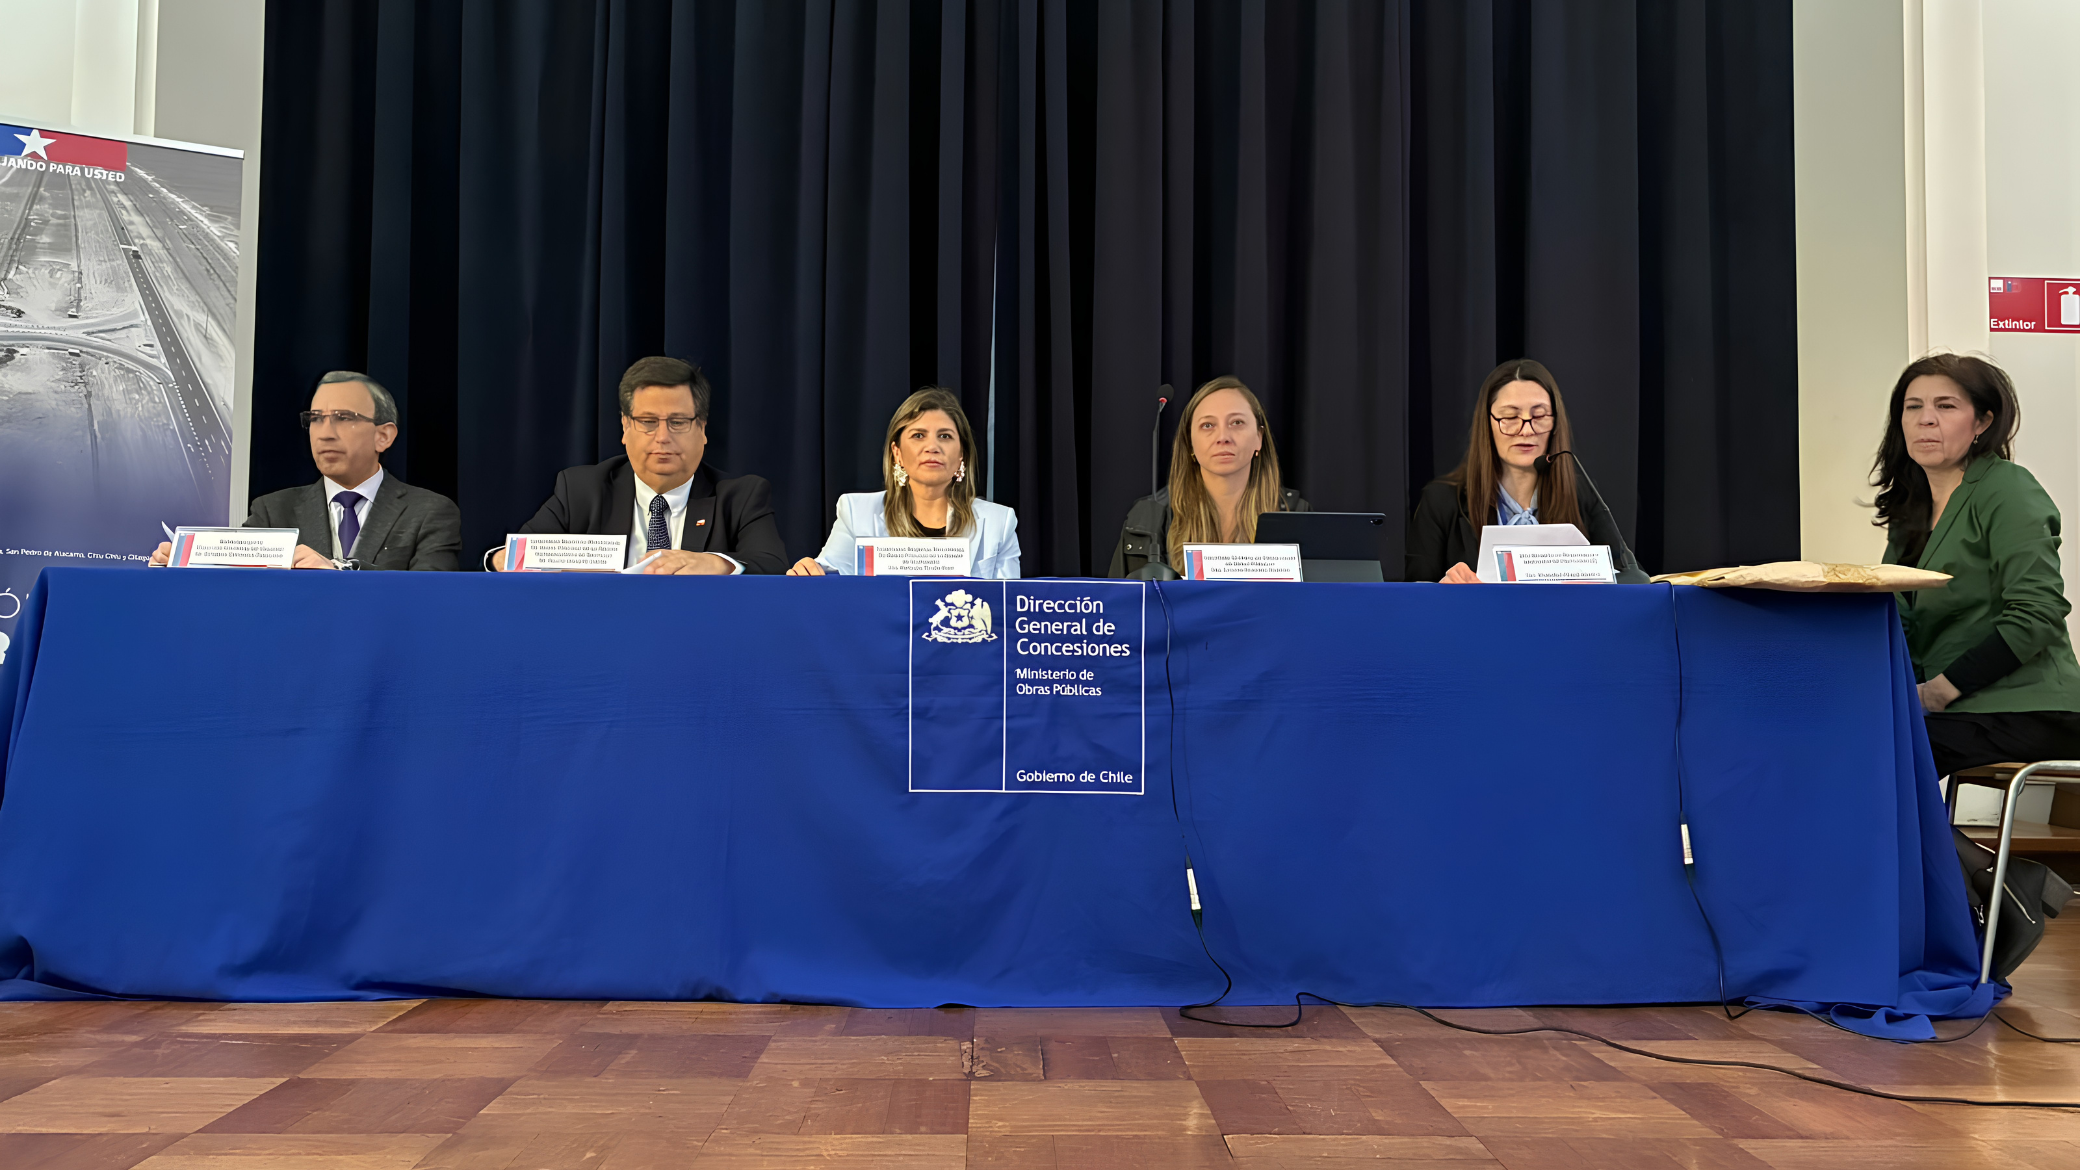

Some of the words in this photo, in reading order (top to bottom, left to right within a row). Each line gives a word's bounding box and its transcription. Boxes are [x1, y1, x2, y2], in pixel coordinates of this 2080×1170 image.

[50, 163, 81, 177] PARA
[84, 167, 125, 182] USTED
[1990, 318, 2036, 330] Extintor
[1017, 595, 1103, 613] Dirección
[1016, 617, 1087, 634] General
[1093, 619, 1115, 635] de
[1017, 638, 1130, 656] Concesiones
[1015, 668, 1076, 679] Ministerio
[1079, 669, 1094, 680] de
[1017, 684, 1050, 694] Obras
[1053, 684, 1101, 696] Públicas
[1017, 770, 1075, 782] Gobierno
[1080, 771, 1095, 782] de
[1100, 771, 1132, 783] Chile
